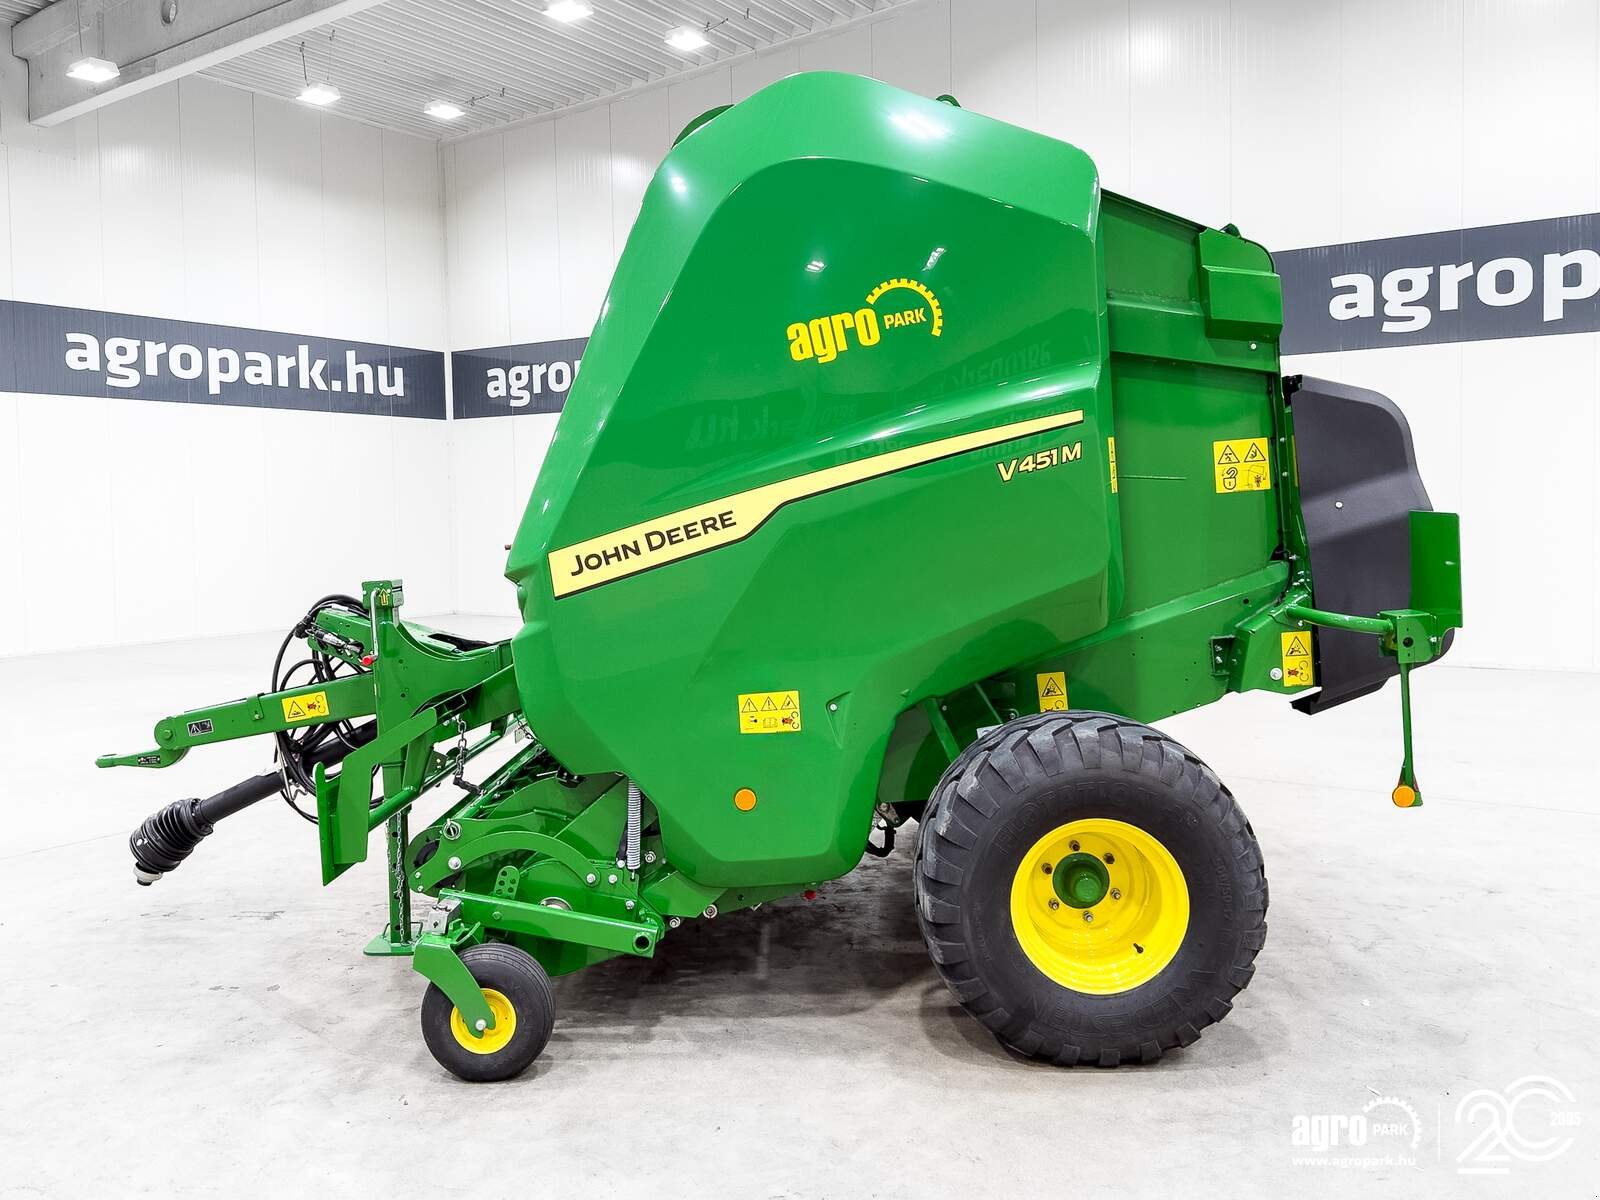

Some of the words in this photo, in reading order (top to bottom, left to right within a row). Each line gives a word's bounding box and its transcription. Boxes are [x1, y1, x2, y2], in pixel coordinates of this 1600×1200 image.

[65, 332, 405, 397] agropark.hu
[786, 308, 881, 364] agro
[883, 307, 927, 330] PARK
[570, 541, 642, 577] JOHN
[645, 511, 738, 553] DEERE
